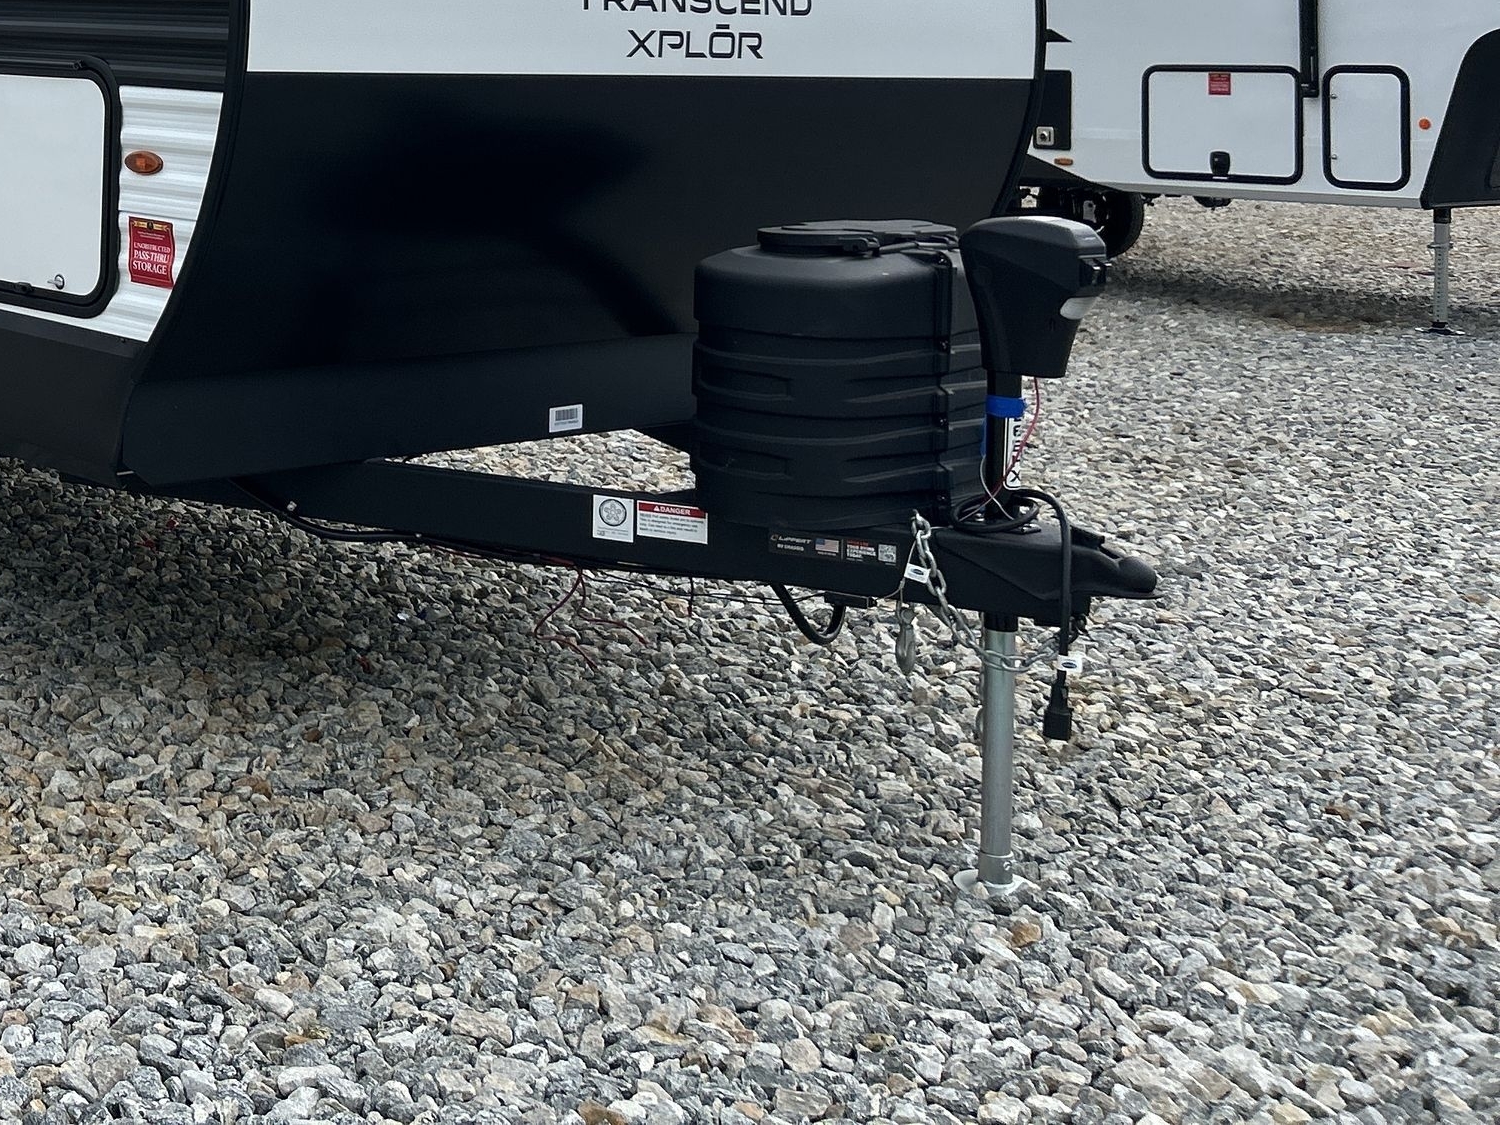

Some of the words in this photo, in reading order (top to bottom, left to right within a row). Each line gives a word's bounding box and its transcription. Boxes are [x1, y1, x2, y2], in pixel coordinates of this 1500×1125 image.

[133, 250, 170, 264] PASS-THRU
[132, 260, 168, 275] STORAGE
[660, 506, 691, 516] DANGER
